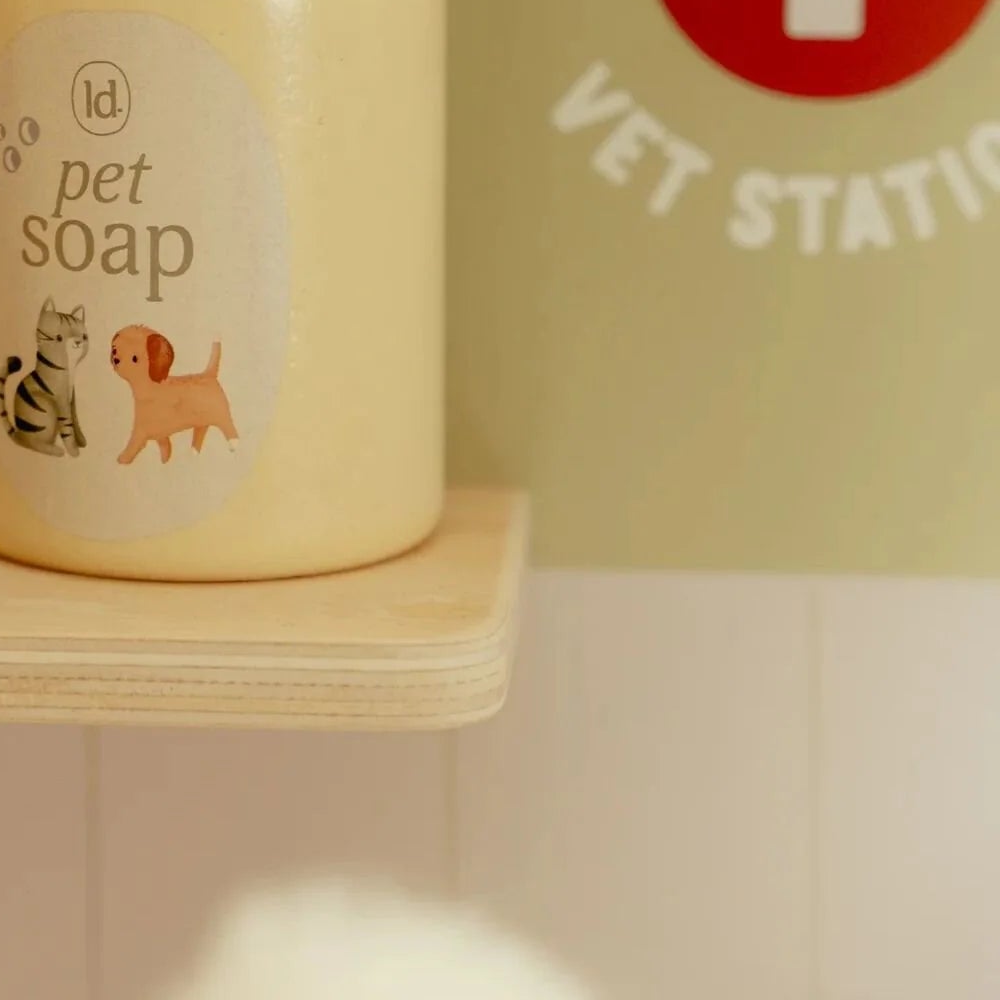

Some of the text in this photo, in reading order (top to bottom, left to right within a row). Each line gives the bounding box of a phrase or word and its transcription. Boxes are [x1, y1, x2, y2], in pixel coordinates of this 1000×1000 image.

[550, 60, 713, 215] VET
[51, 153, 153, 219] pet
[21, 214, 195, 303] soap
